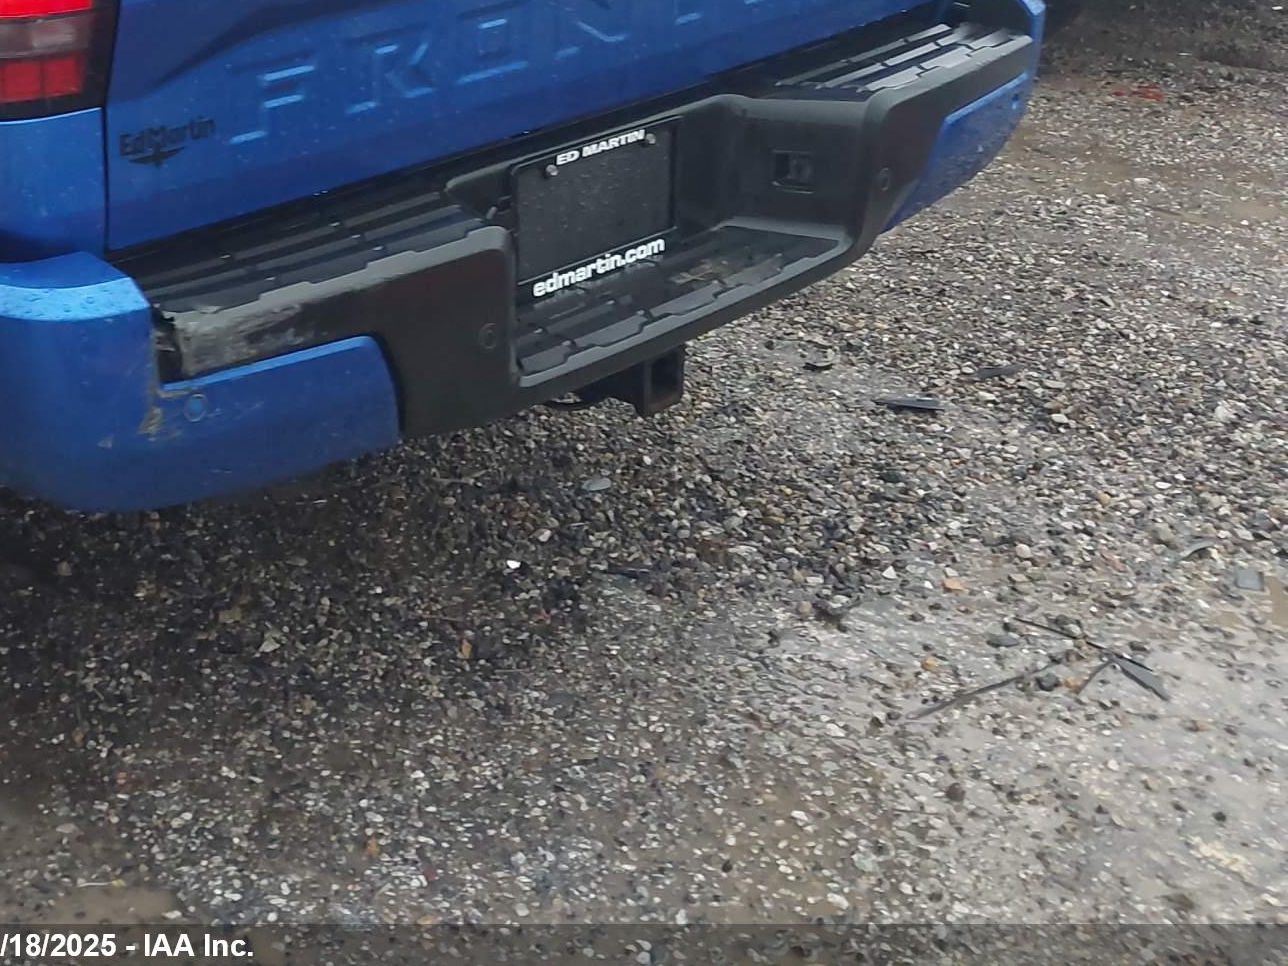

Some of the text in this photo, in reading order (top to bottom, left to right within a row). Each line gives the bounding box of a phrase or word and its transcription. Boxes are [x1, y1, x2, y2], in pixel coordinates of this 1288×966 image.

[556, 129, 645, 165] ED MARTIN
[533, 238, 665, 297] edmartin.com
